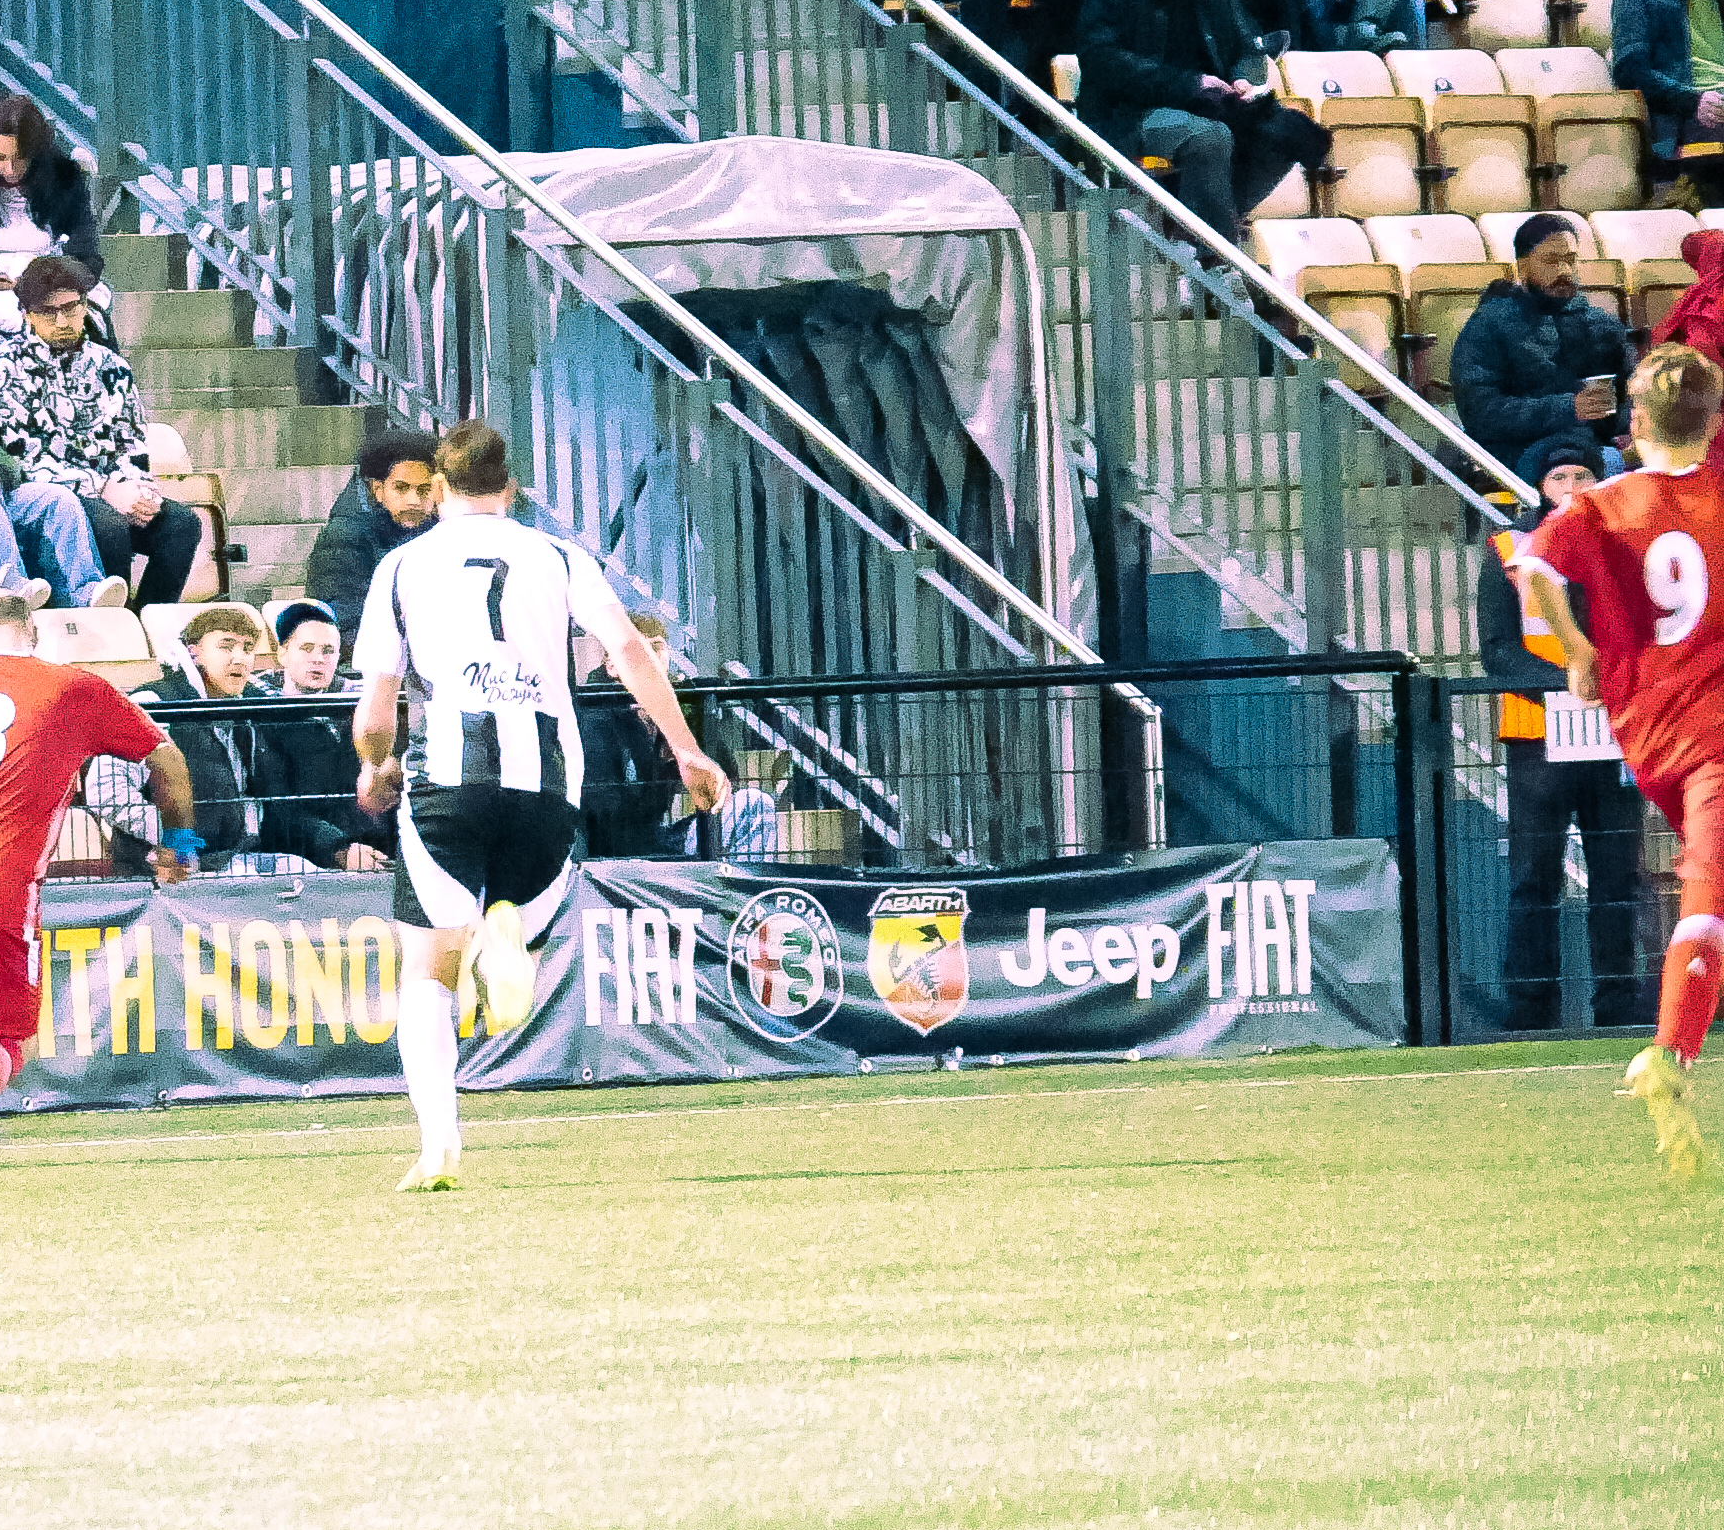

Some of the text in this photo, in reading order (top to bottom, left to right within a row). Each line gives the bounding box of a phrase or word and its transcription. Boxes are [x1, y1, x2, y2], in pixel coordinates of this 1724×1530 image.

[463, 557, 509, 642] 7
[1643, 530, 1709, 646] 9
[515, 662, 541, 687] Lee
[734, 895, 836, 965] ALFA ROMEO
[879, 895, 962, 913] ABARTH
[1205, 879, 1316, 998] FIAT
[582, 907, 703, 1027] FIAT
[998, 907, 1181, 999] Jeep
[1209, 1002, 1318, 1015] PROFESSIONAL
